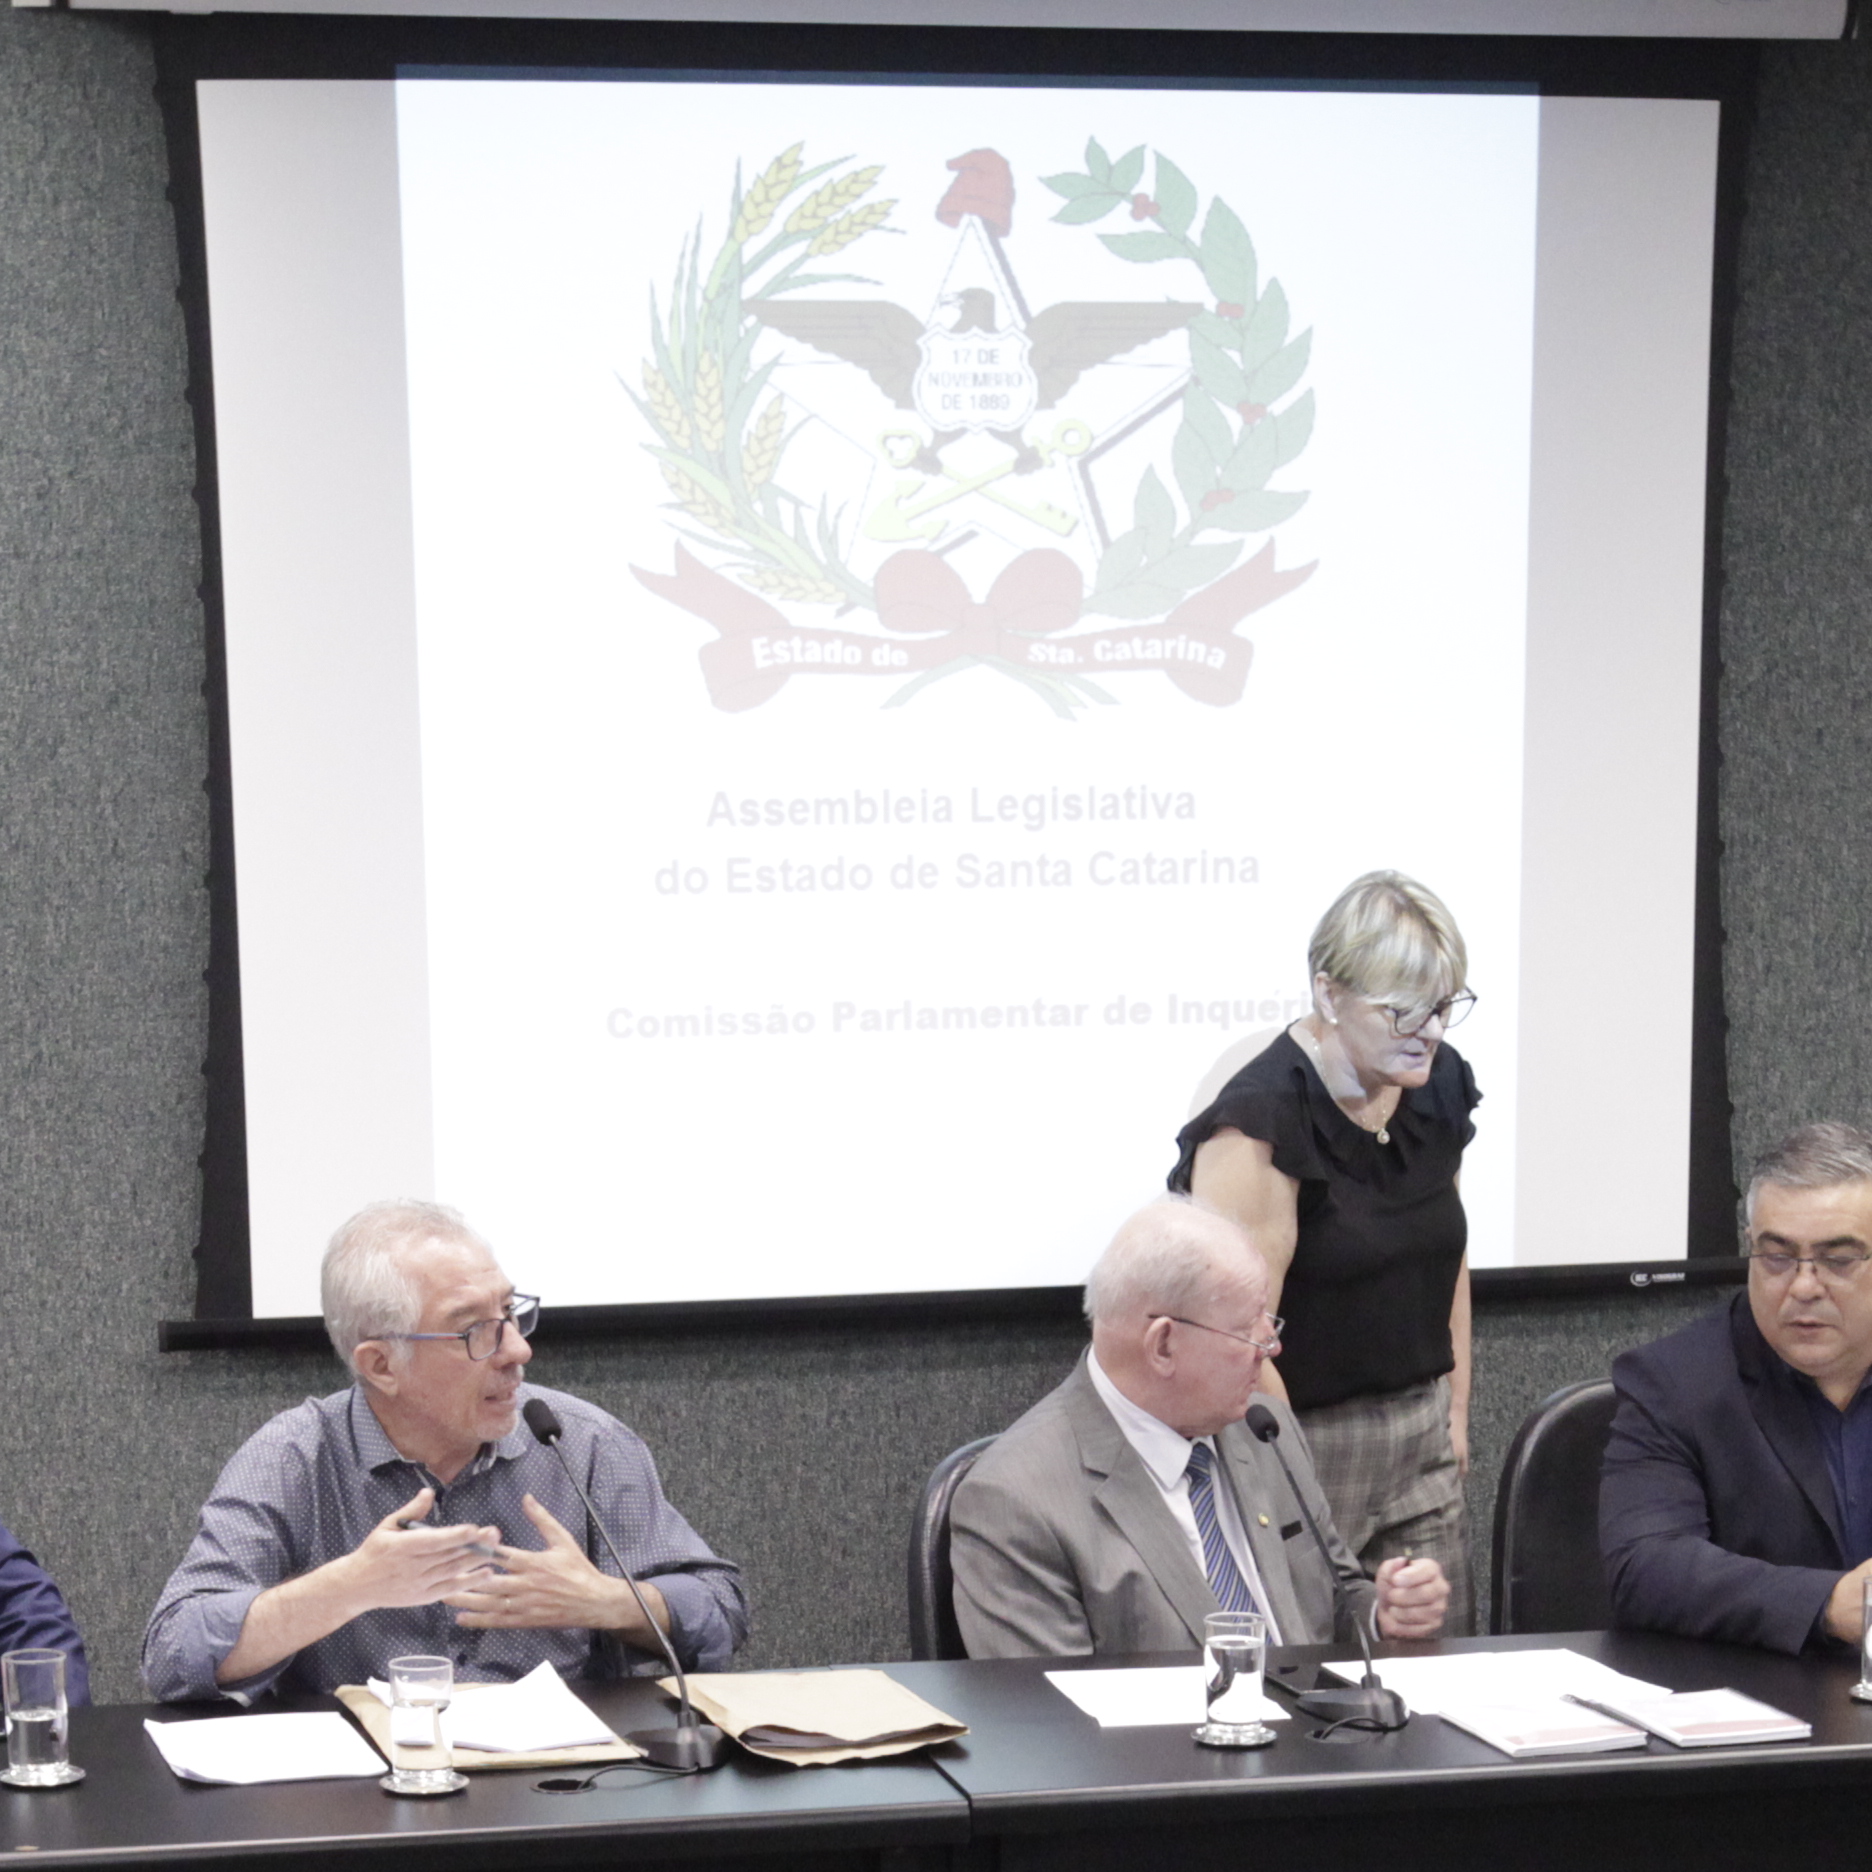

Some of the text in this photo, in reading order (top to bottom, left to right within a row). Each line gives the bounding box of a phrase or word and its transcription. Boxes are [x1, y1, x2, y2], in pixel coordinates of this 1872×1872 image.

[952, 347, 1000, 365] 17 DE
[941, 393, 1011, 410] DE 1889
[750, 636, 909, 669] Estado de
[1027, 634, 1227, 671] Sta. Catarina
[706, 784, 1198, 832] Assembleia Legislativa
[653, 848, 1262, 896] do Estado de Santa Catarina
[605, 989, 1311, 1039] Comissão Parlamentar de Inquéri
